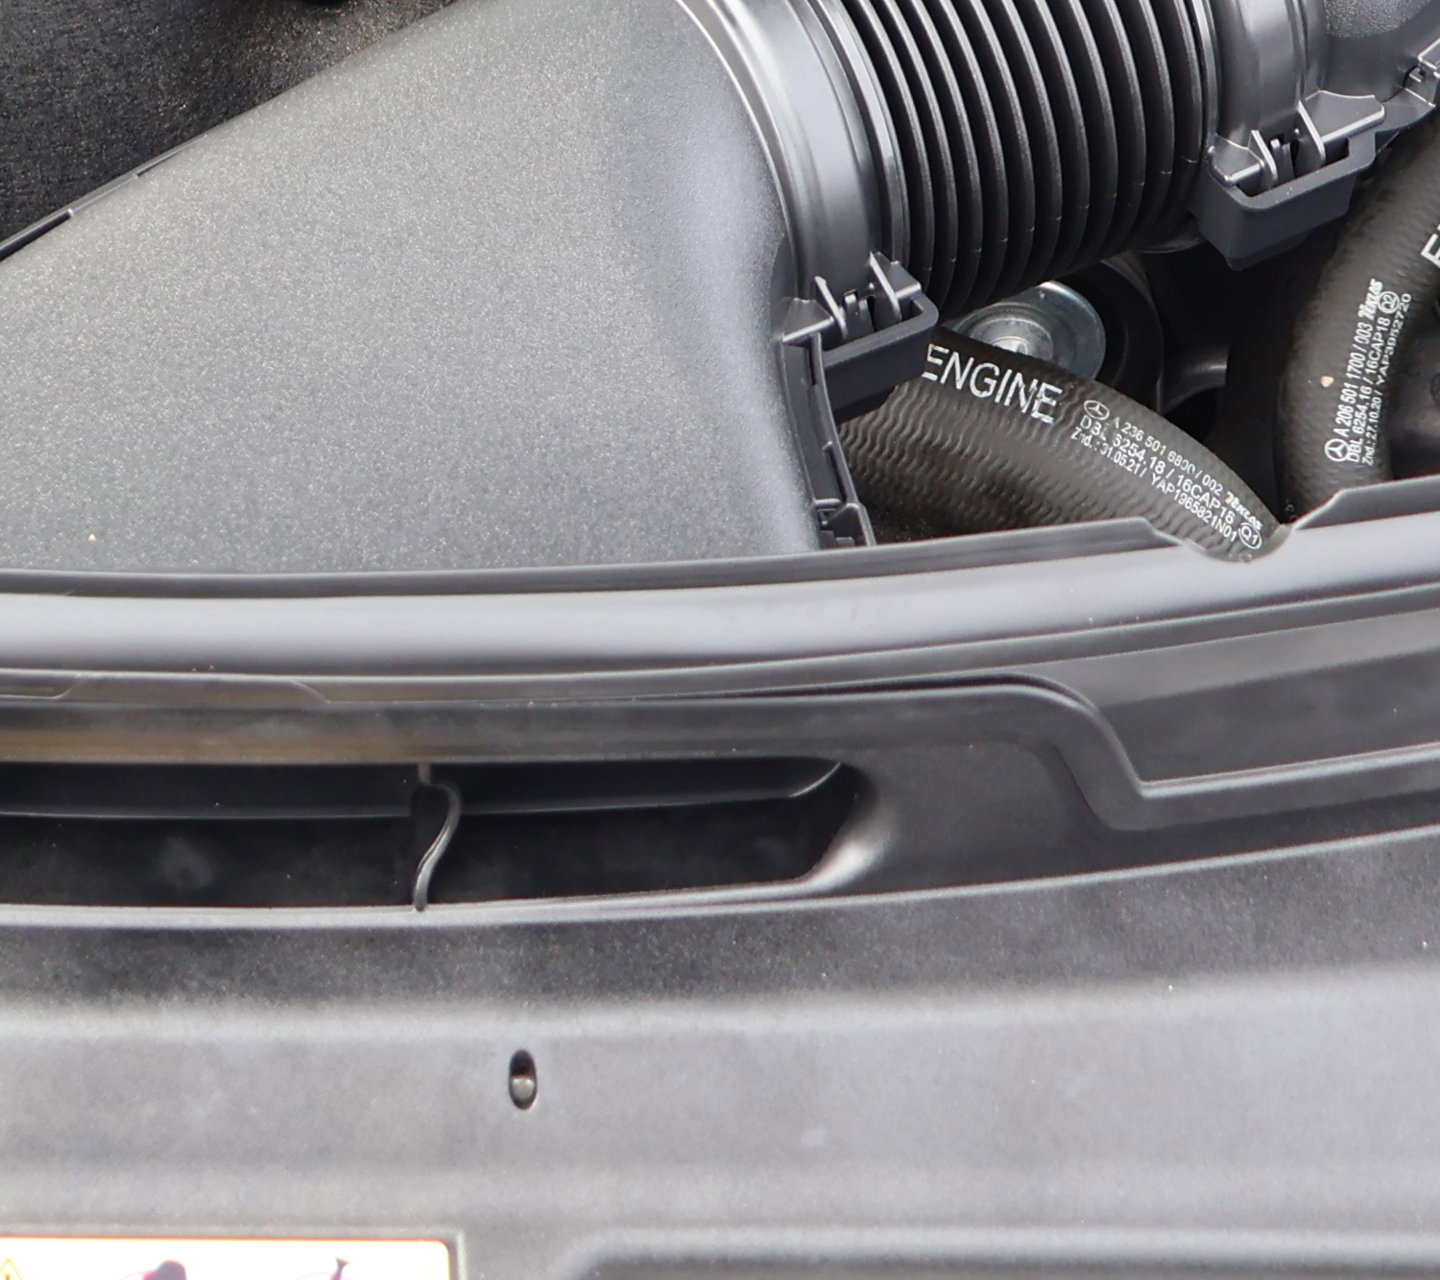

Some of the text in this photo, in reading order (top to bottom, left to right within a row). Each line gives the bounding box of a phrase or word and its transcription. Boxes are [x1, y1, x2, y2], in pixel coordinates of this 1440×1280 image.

[1364, 315, 1391, 376] 16CAP18
[1345, 351, 1366, 380] 1700
[921, 343, 1063, 425] ENGINE
[1339, 382, 1360, 404] 501
[1335, 404, 1355, 426] 206
[1352, 385, 1372, 435] 6254.16
[1333, 426, 1350, 438] A
[1122, 421, 1144, 443] 236
[1147, 434, 1167, 456] 501
[1203, 470, 1224, 496] 002
[1347, 437, 1364, 463] DBL
